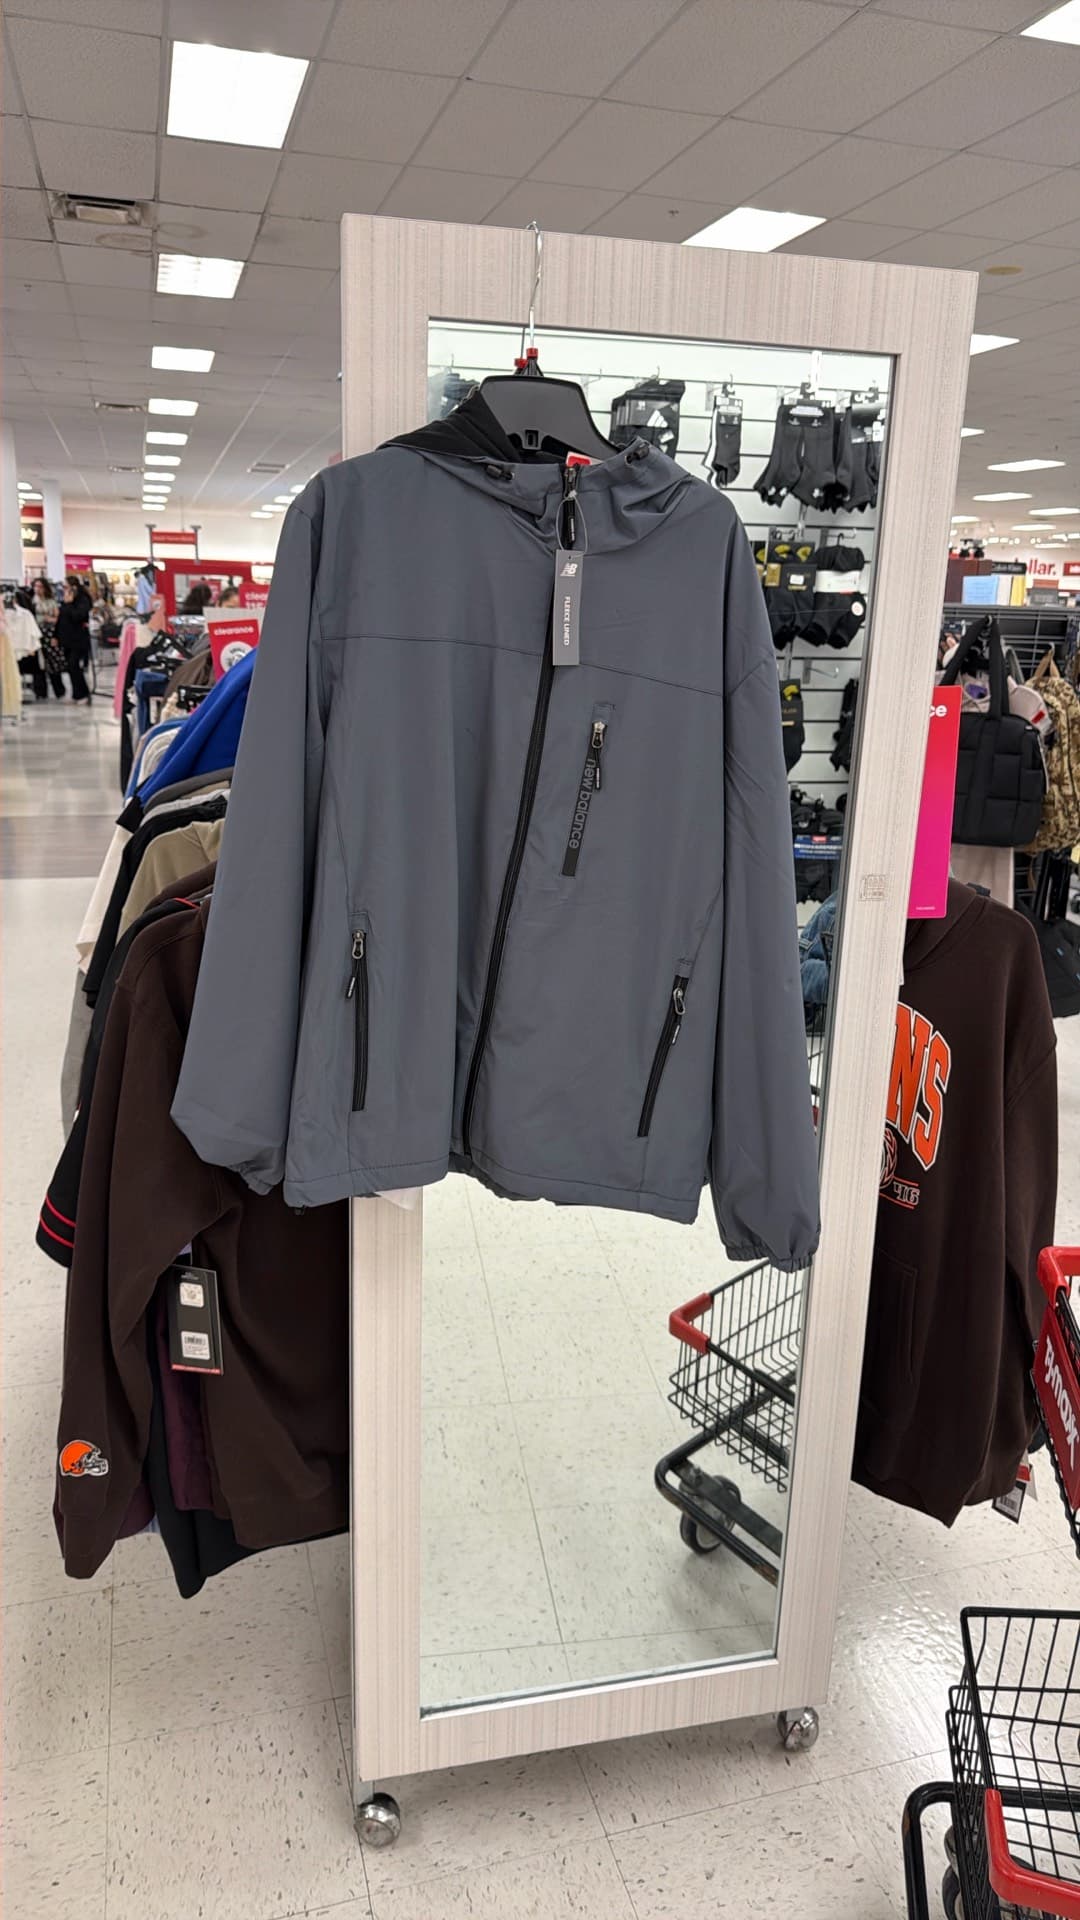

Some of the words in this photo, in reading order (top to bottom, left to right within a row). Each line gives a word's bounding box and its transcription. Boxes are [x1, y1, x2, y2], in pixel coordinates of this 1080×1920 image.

[563, 596, 571, 622] FLEECE
[213, 624, 255, 636] clearance
[563, 623, 571, 646] LINED
[580, 758, 596, 789] new
[568, 789, 593, 849] balance
